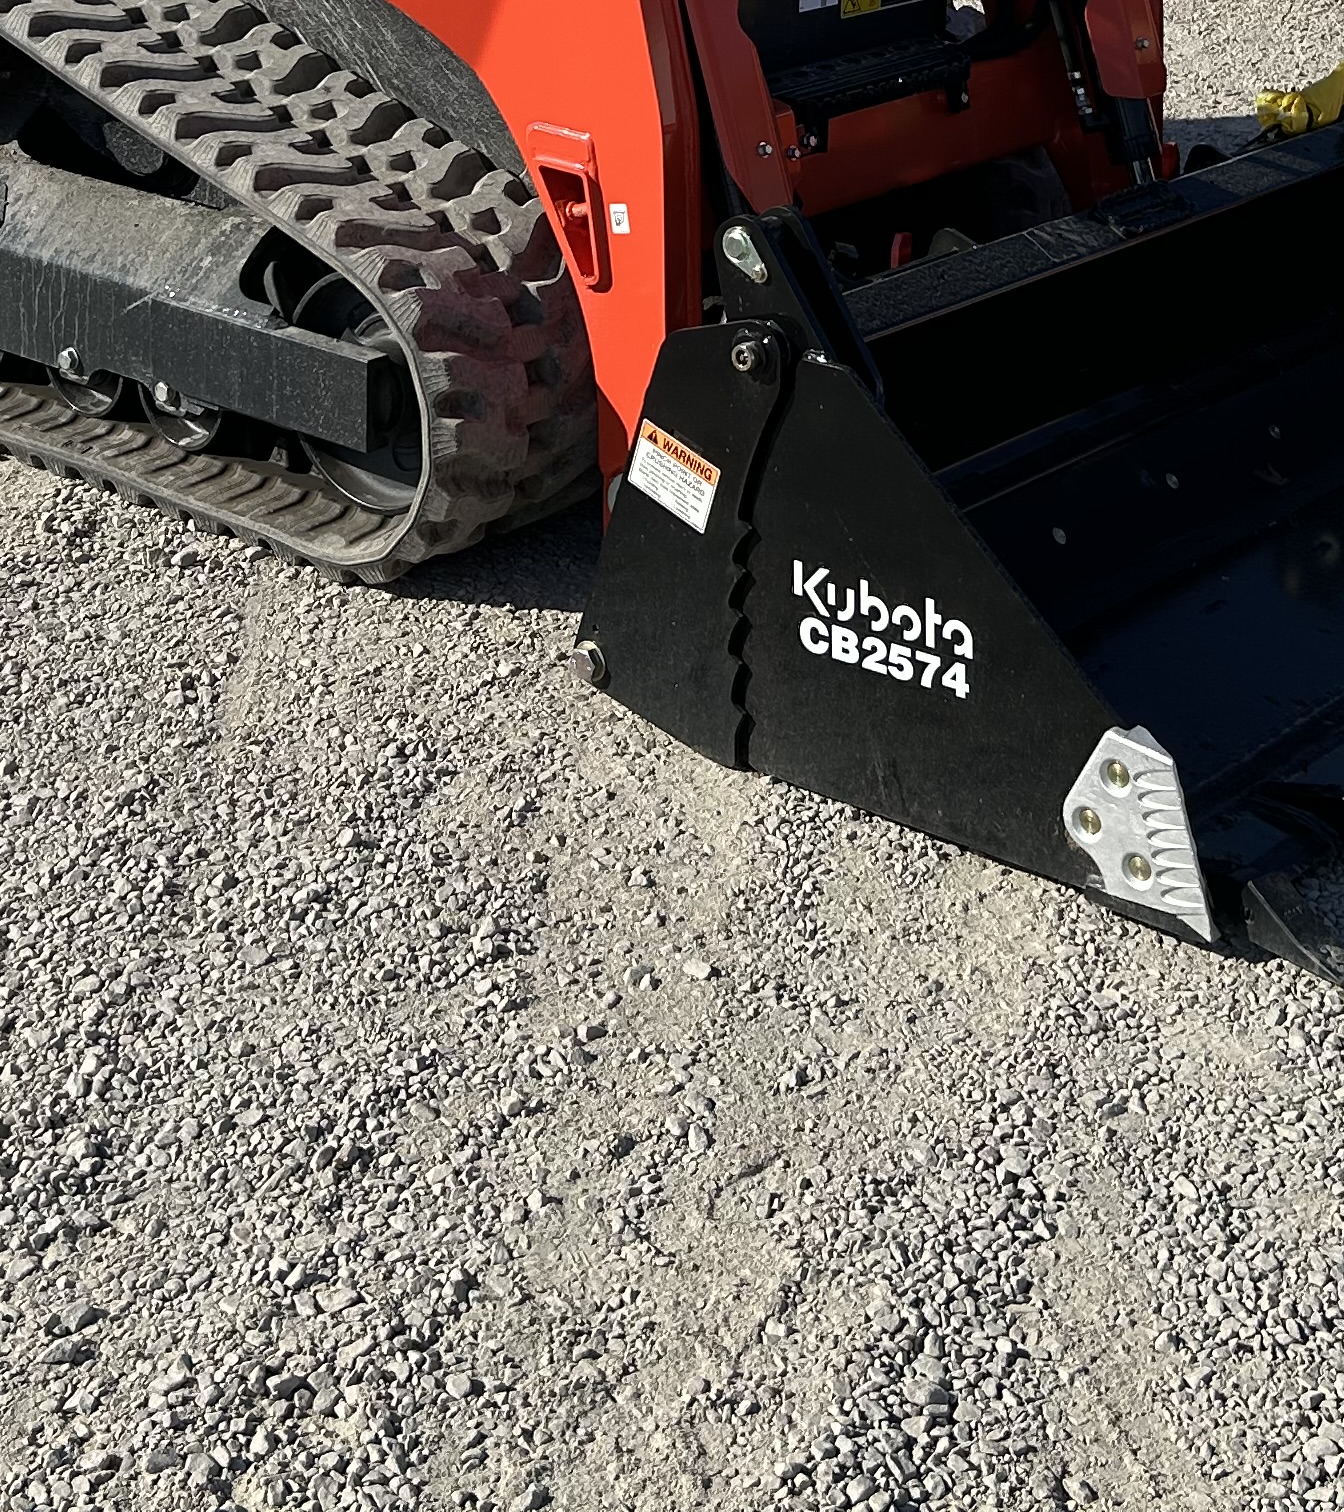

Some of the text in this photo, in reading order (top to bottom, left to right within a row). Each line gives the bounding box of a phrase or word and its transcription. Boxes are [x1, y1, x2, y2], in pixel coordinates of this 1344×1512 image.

[662, 437, 713, 481] WARNING
[793, 559, 974, 660] Kubota
[799, 616, 970, 700] CB2574
